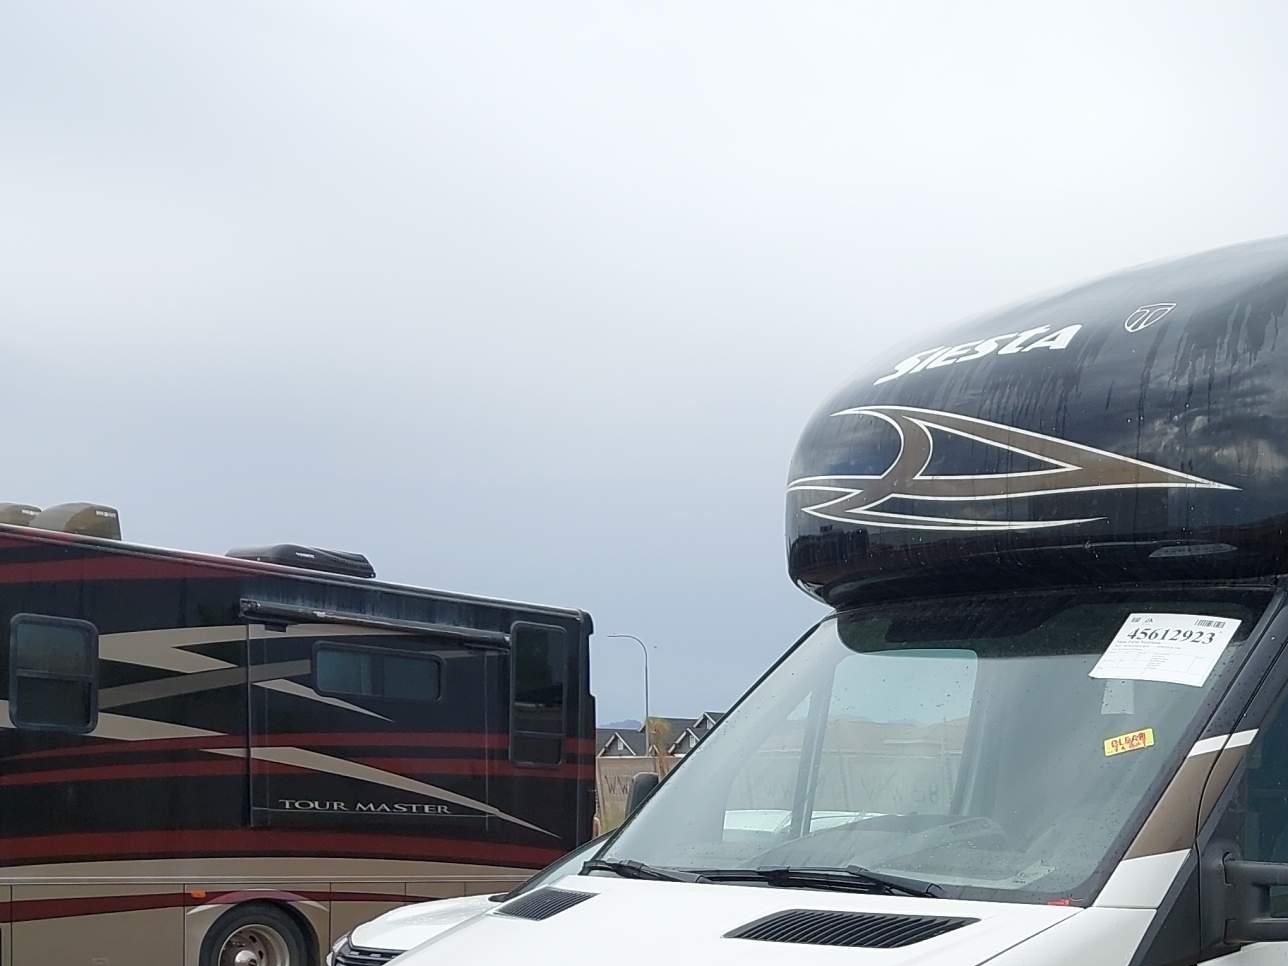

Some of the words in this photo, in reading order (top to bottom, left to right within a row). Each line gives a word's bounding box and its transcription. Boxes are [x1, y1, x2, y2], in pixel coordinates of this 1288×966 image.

[1127, 627, 1216, 645] 45612923
[279, 799, 348, 811] TOUR
[355, 802, 451, 814] MASTER
